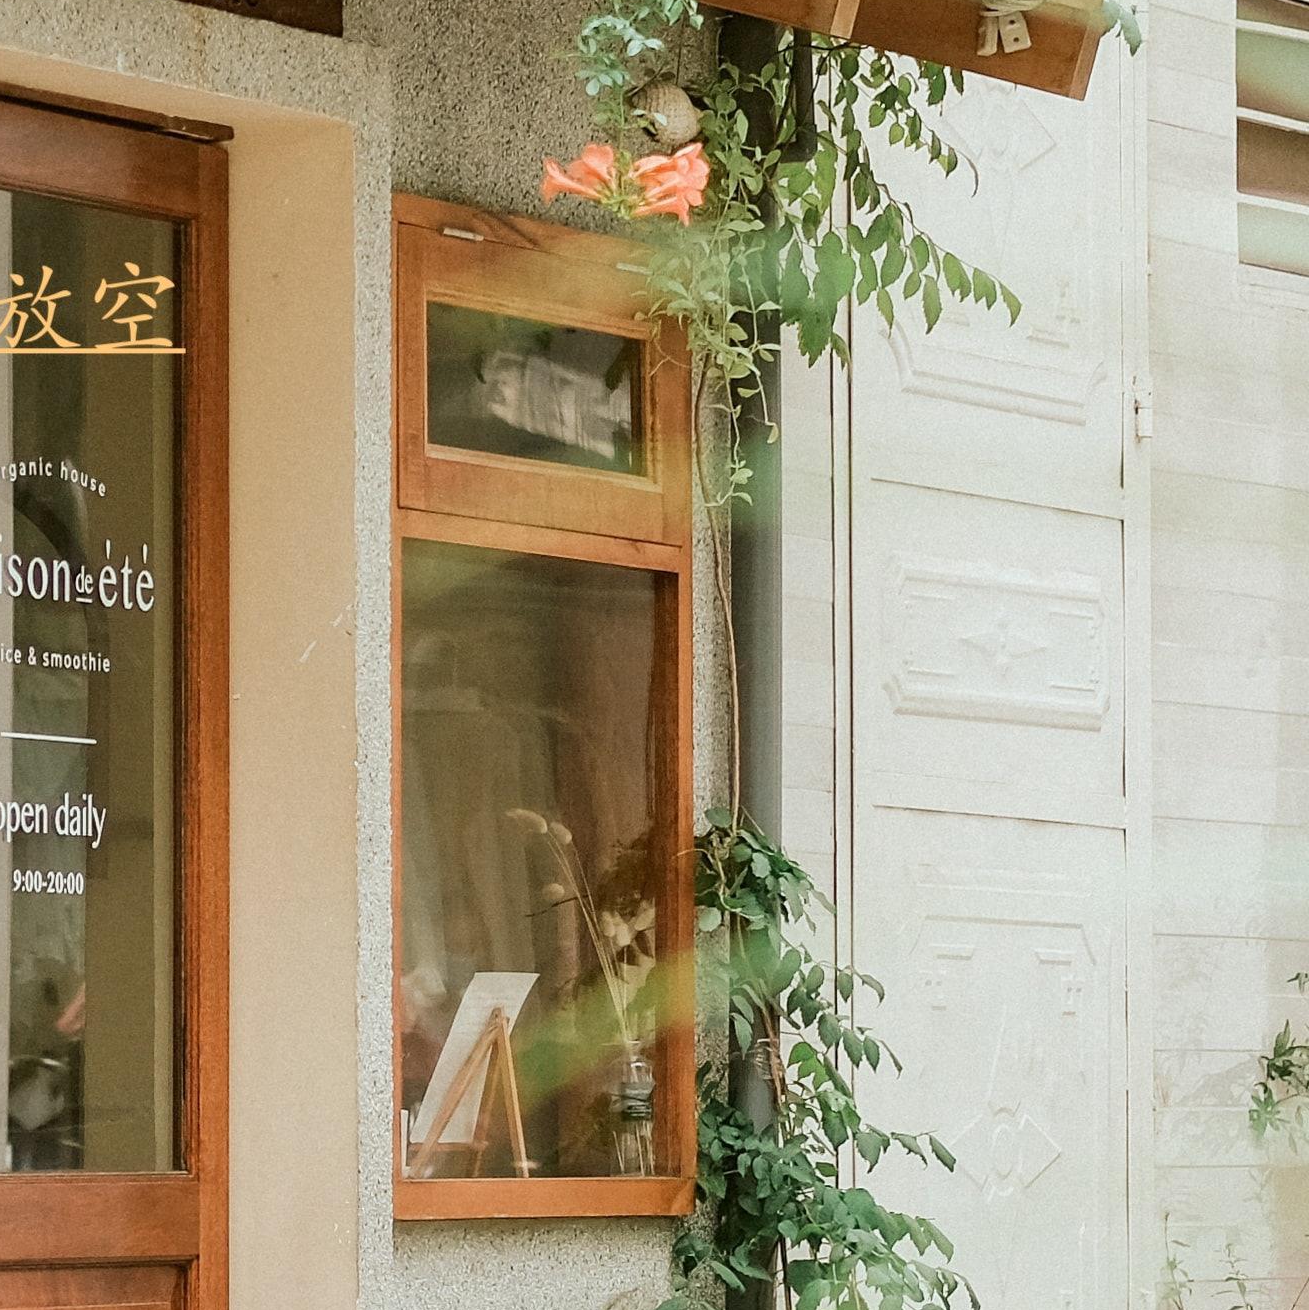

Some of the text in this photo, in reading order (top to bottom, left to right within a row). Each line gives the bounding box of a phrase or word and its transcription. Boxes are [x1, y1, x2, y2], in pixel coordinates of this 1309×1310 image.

[60, 461, 107, 497] house
[75, 565, 94, 595] de
[27, 646, 37, 665] &
[42, 651, 111, 672] smoothie
[55, 792, 107, 849] daily
[12, 869, 84, 895] 9:00-20:00
